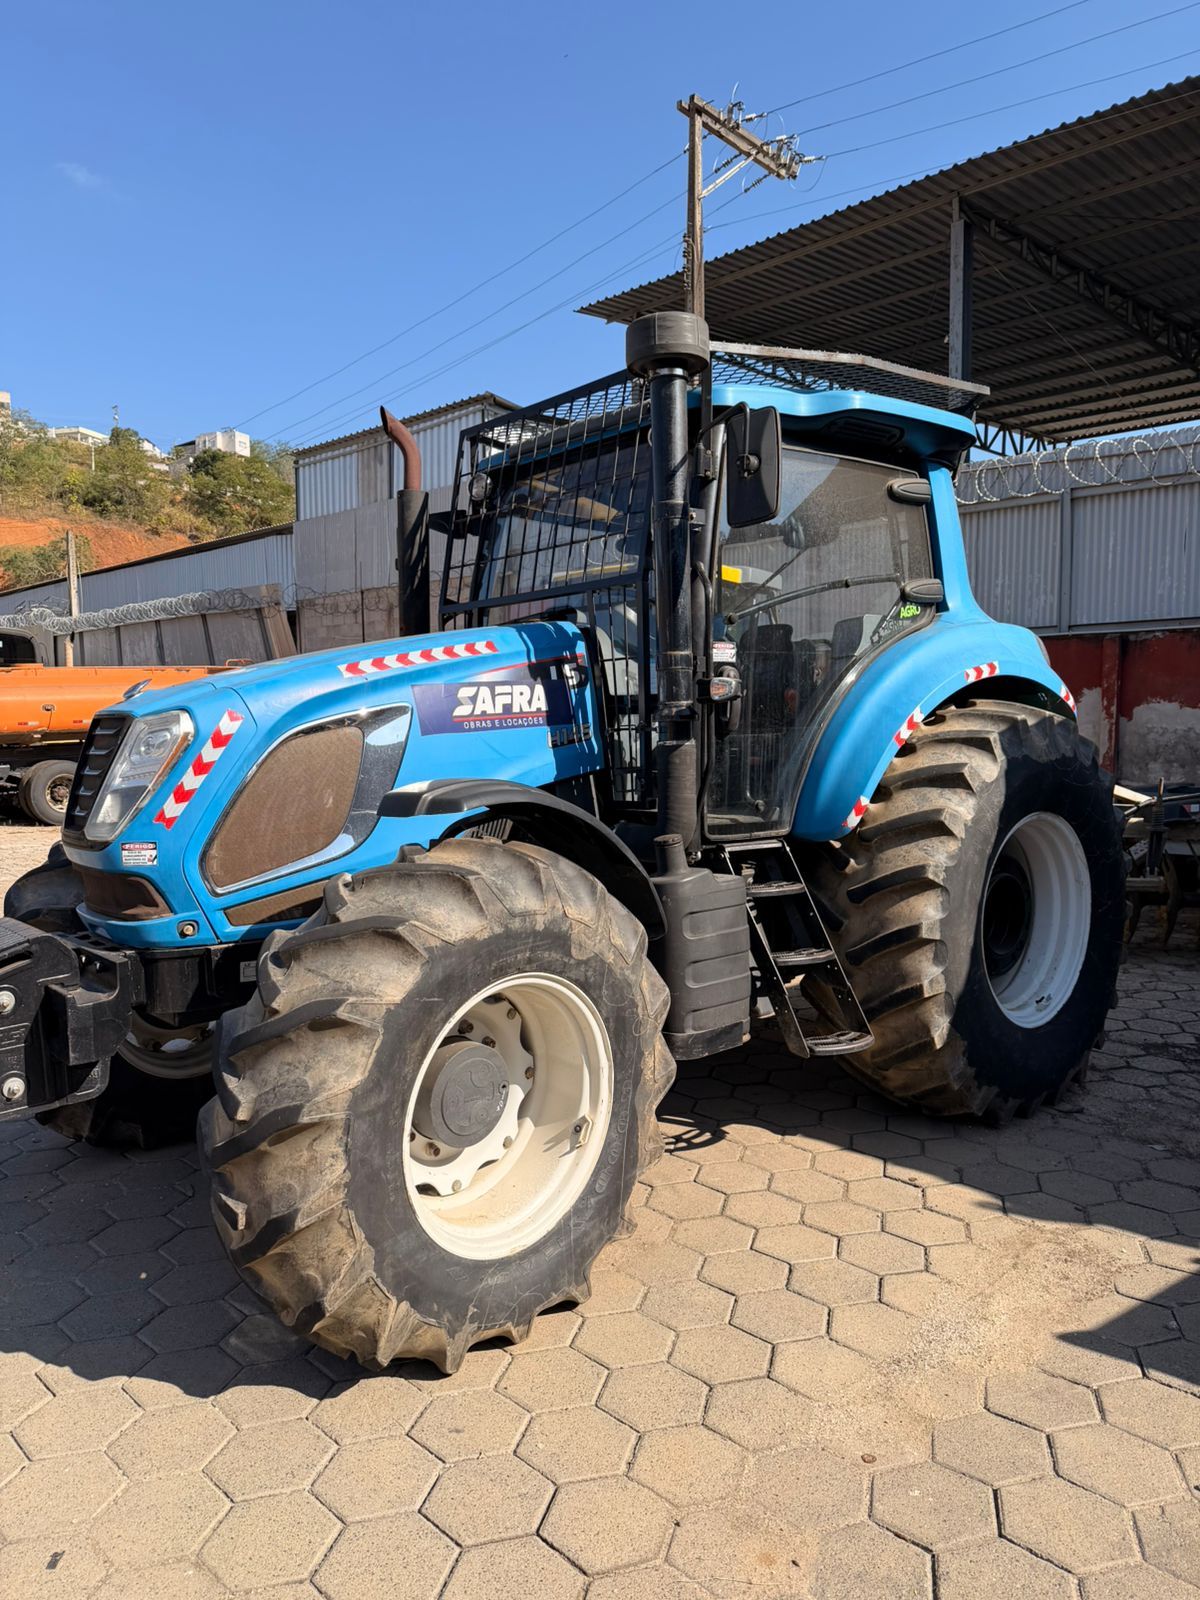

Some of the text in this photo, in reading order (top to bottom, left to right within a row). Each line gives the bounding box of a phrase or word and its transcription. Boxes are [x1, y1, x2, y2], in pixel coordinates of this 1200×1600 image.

[452, 684, 548, 716] SAFRA
[463, 716, 544, 729] OBRAS E LOCAÇÕES
